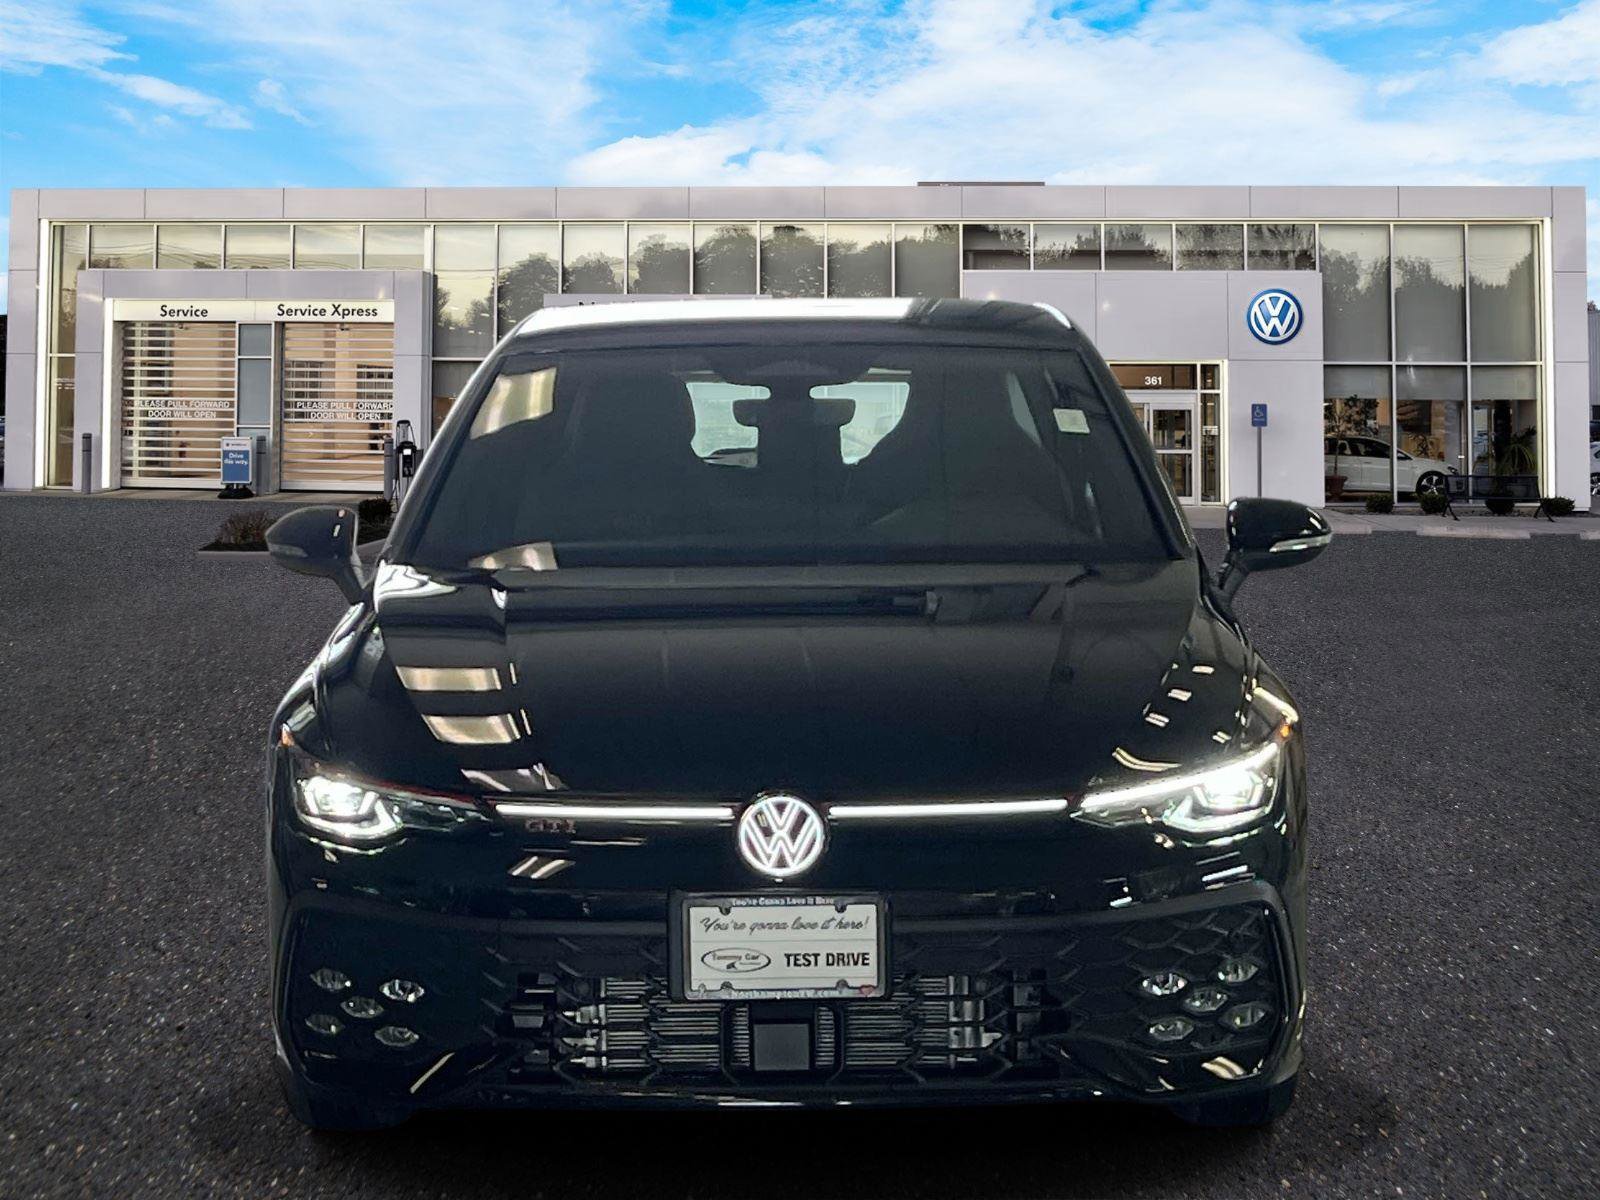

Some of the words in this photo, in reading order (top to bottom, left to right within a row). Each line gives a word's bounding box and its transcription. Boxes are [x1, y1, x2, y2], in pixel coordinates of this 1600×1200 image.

[159, 304, 209, 318] Service
[276, 303, 327, 317] Service
[330, 303, 378, 319] Xpress
[1144, 376, 1162, 385] 361
[167, 400, 188, 408] PULL
[190, 400, 230, 409] FORWARD
[296, 401, 329, 409] PLEASE
[330, 401, 352, 410] PULL
[353, 401, 394, 411] FORWARD
[148, 410, 172, 418] DOOR
[173, 410, 193, 418] WILL
[194, 411, 217, 419] OPEN
[310, 412, 335, 420] DOOR
[336, 412, 356, 420] WILL
[357, 412, 381, 420] OPEN
[700, 916, 747, 933] You're
[749, 920, 789, 936] gonna
[790, 915, 819, 931] love
[835, 915, 871, 931] here!
[745, 953, 761, 961] Car
[784, 953, 821, 968] TEST
[826, 952, 870, 967] DRIVE
